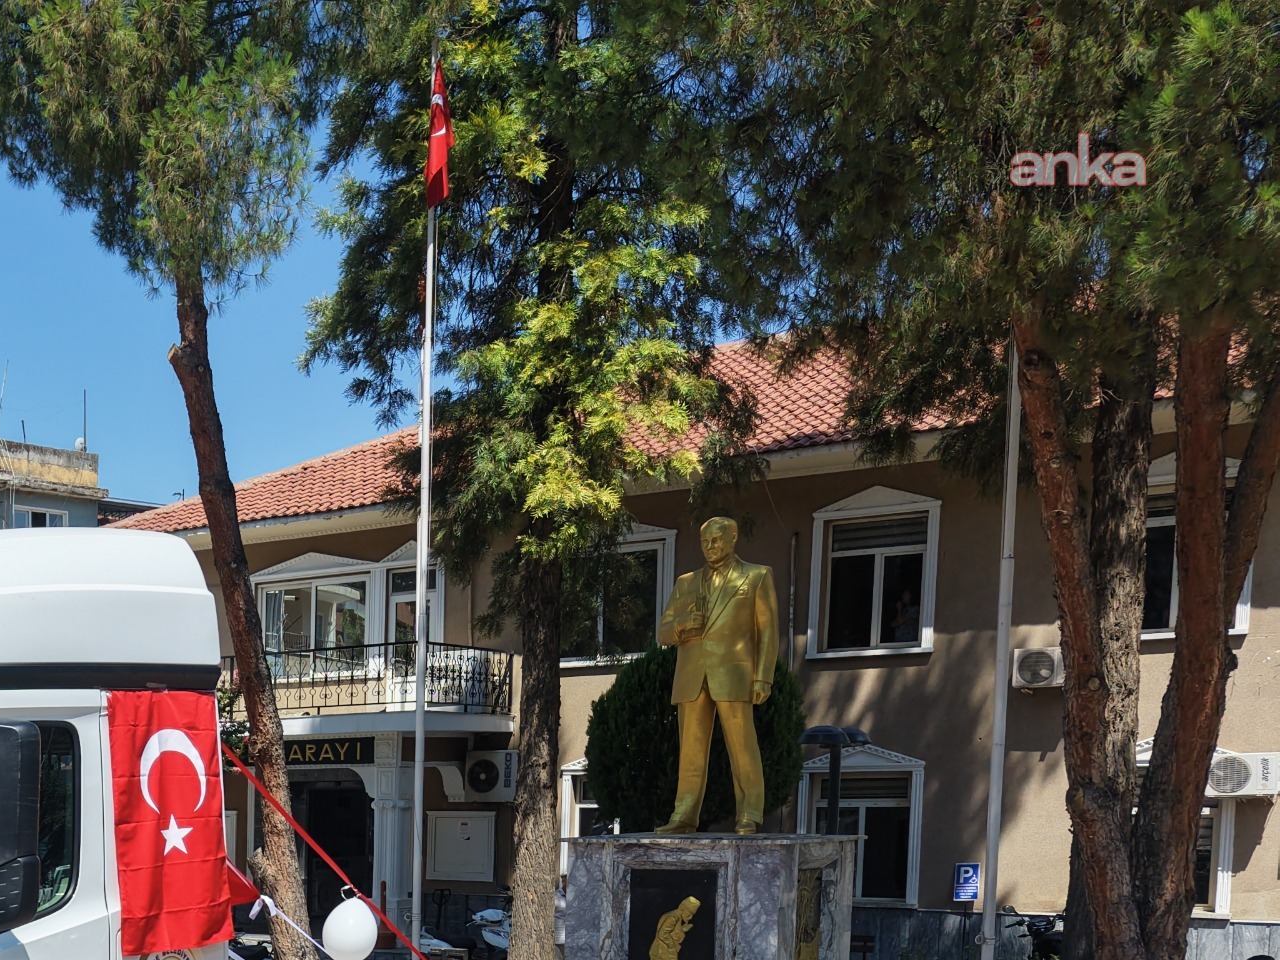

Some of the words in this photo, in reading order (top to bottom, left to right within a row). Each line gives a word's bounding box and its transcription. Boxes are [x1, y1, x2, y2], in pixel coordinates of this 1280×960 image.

[288, 742, 361, 761] ARAYI
[503, 752, 513, 788] BEKO
[1260, 757, 1272, 782] arçelik
